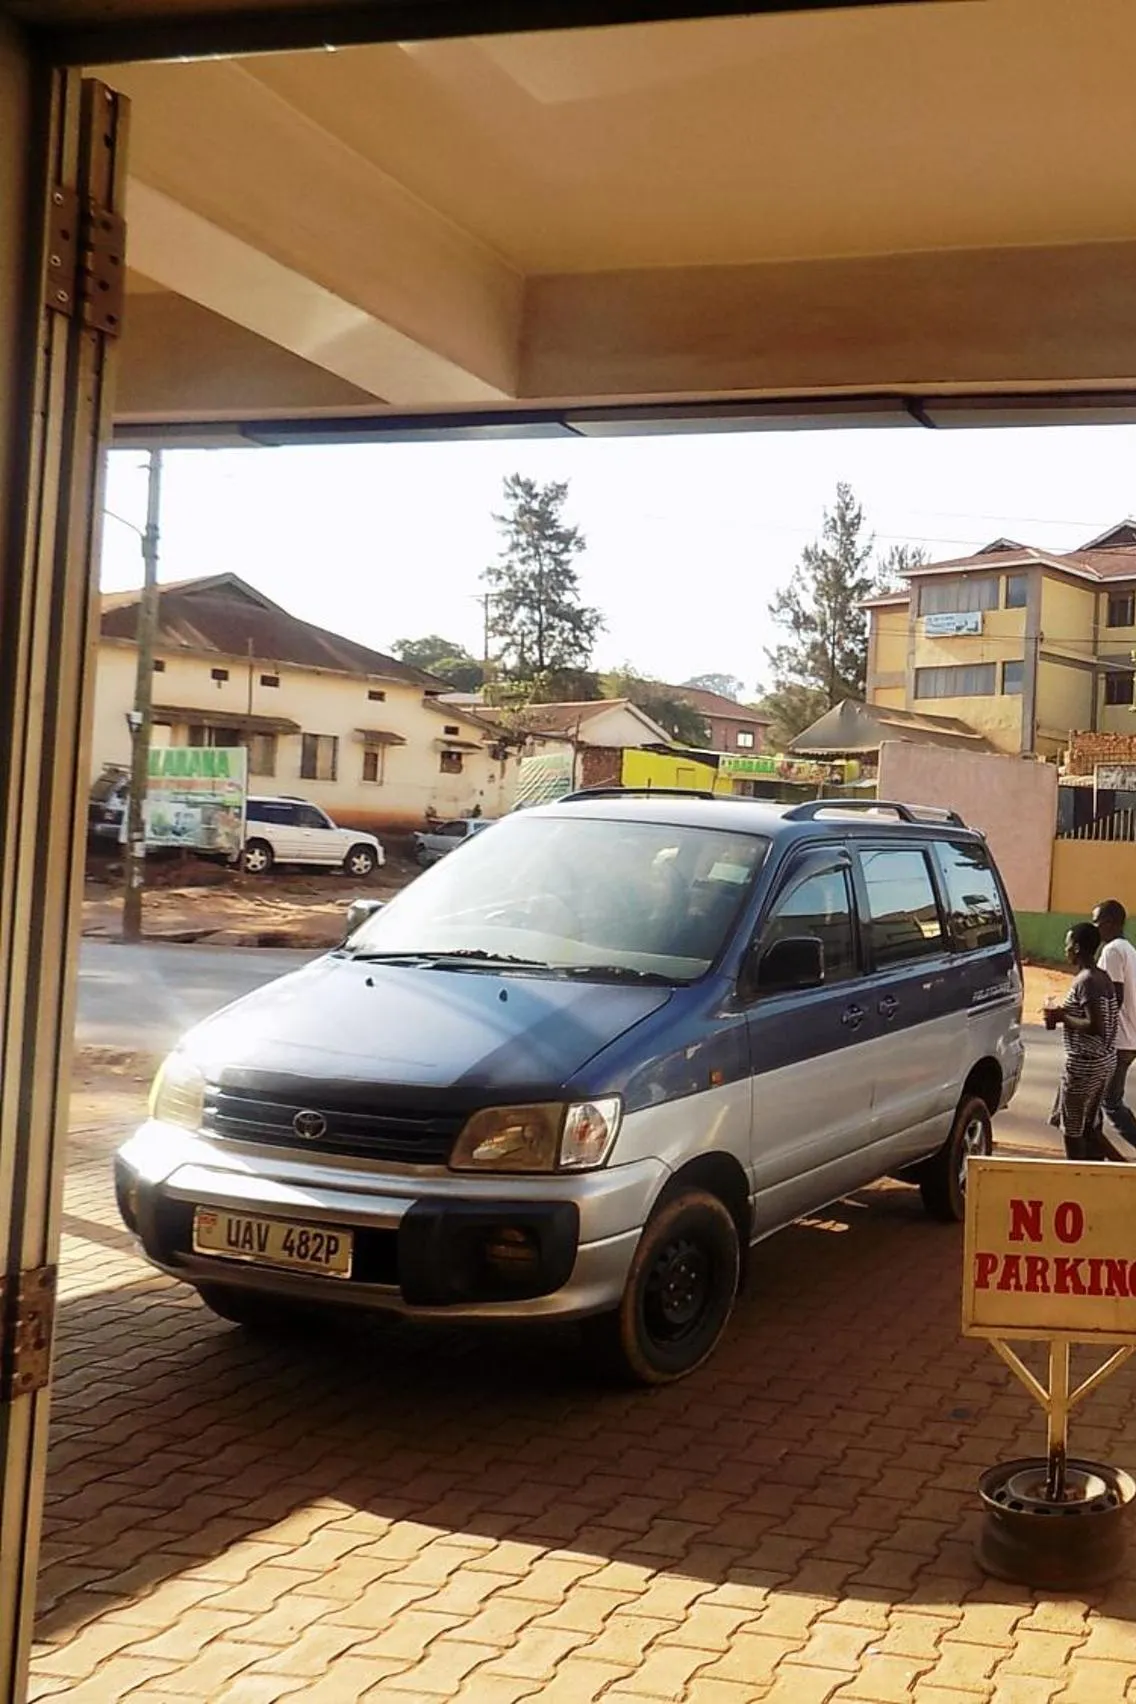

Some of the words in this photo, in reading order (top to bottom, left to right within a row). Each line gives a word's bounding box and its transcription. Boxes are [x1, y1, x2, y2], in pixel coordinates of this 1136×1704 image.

[226, 1217, 271, 1253] UAV
[281, 1228, 340, 1265] 482P
[1008, 1199, 1084, 1244] NO
